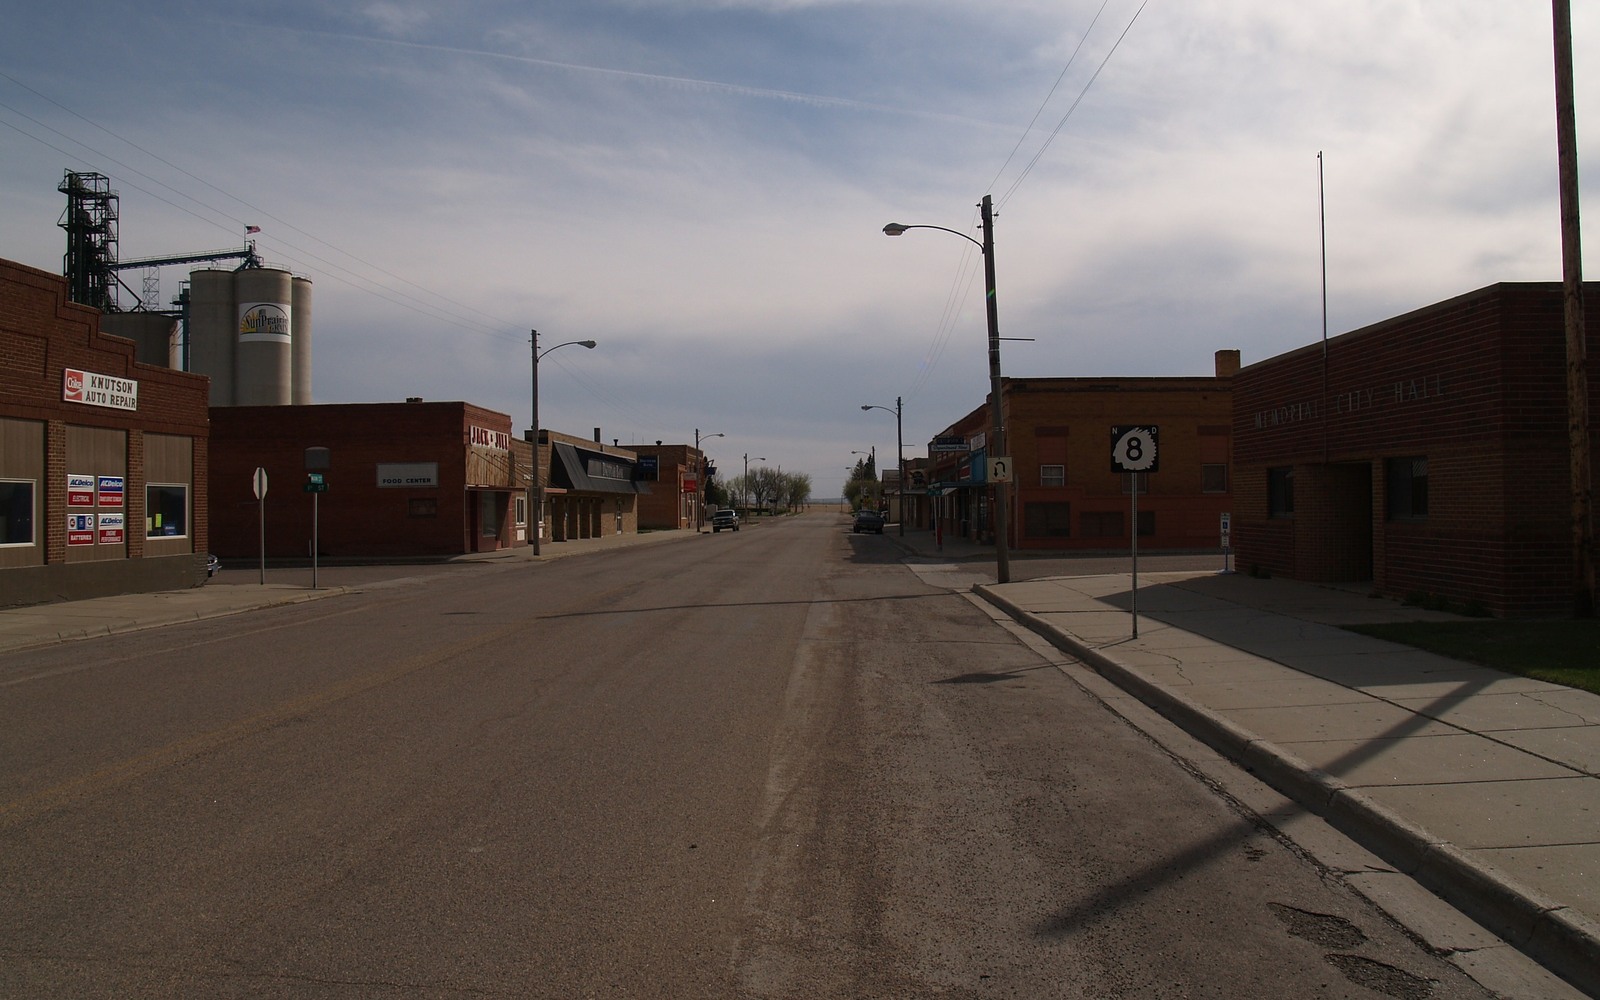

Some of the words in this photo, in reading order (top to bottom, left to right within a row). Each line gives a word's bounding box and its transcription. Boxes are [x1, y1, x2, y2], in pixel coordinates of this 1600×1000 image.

[91, 375, 133, 394] KNUTSON
[86, 391, 106, 404] AUTO
[110, 395, 136, 408] REPAIR
[1255, 400, 1319, 430] MEMORIAL
[1336, 387, 1374, 414] CITY
[1394, 374, 1444, 403] HALL
[1112, 427, 1118, 435] N
[1126, 436, 1143, 461] 8
